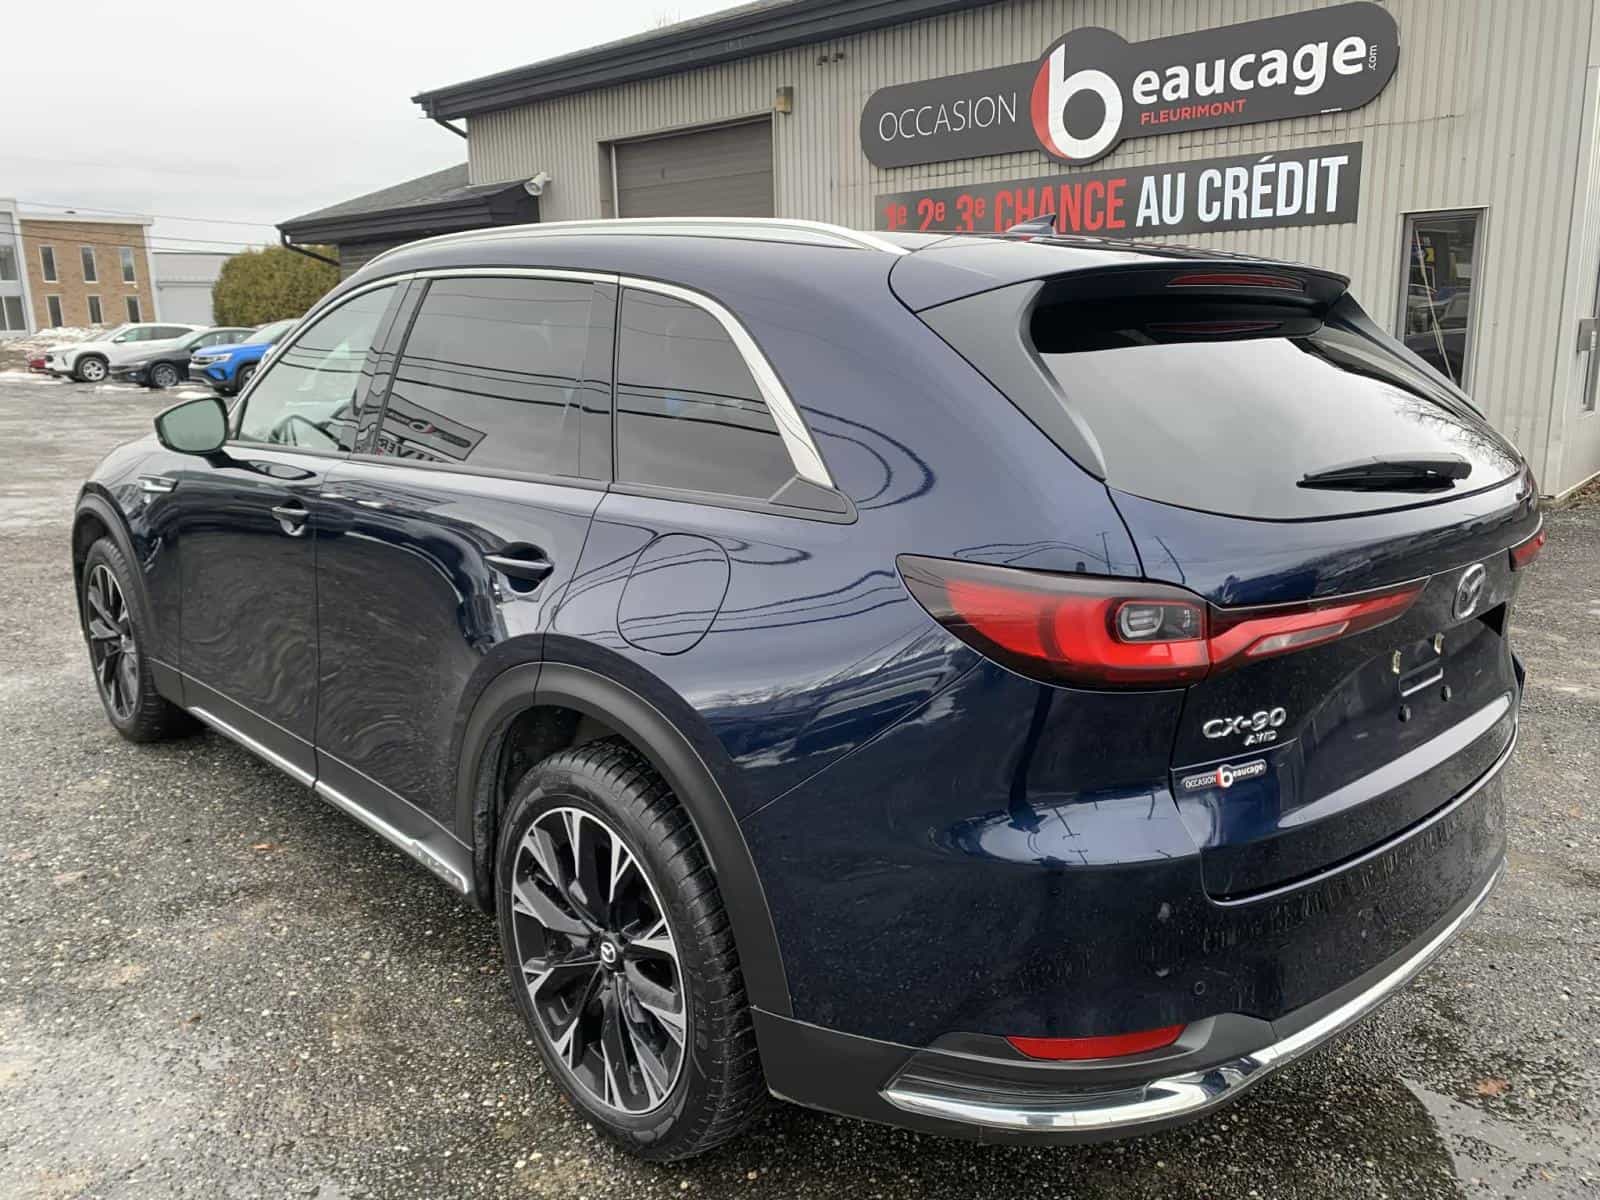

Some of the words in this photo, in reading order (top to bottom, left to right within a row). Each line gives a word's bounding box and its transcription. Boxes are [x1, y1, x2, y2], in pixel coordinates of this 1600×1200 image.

[878, 91, 1017, 142] OCCASION
[1140, 99, 1247, 125] FLEURIMONT
[884, 202, 908, 232] 1e
[917, 198, 946, 232] 2e
[956, 194, 985, 233] 3e
[994, 178, 1127, 233] CHANCE
[1136, 172, 1186, 227] AU
[1198, 155, 1349, 222] CRÉDIT
[1202, 706, 1287, 739] CX-90
[1185, 775, 1217, 789] OCCASION
